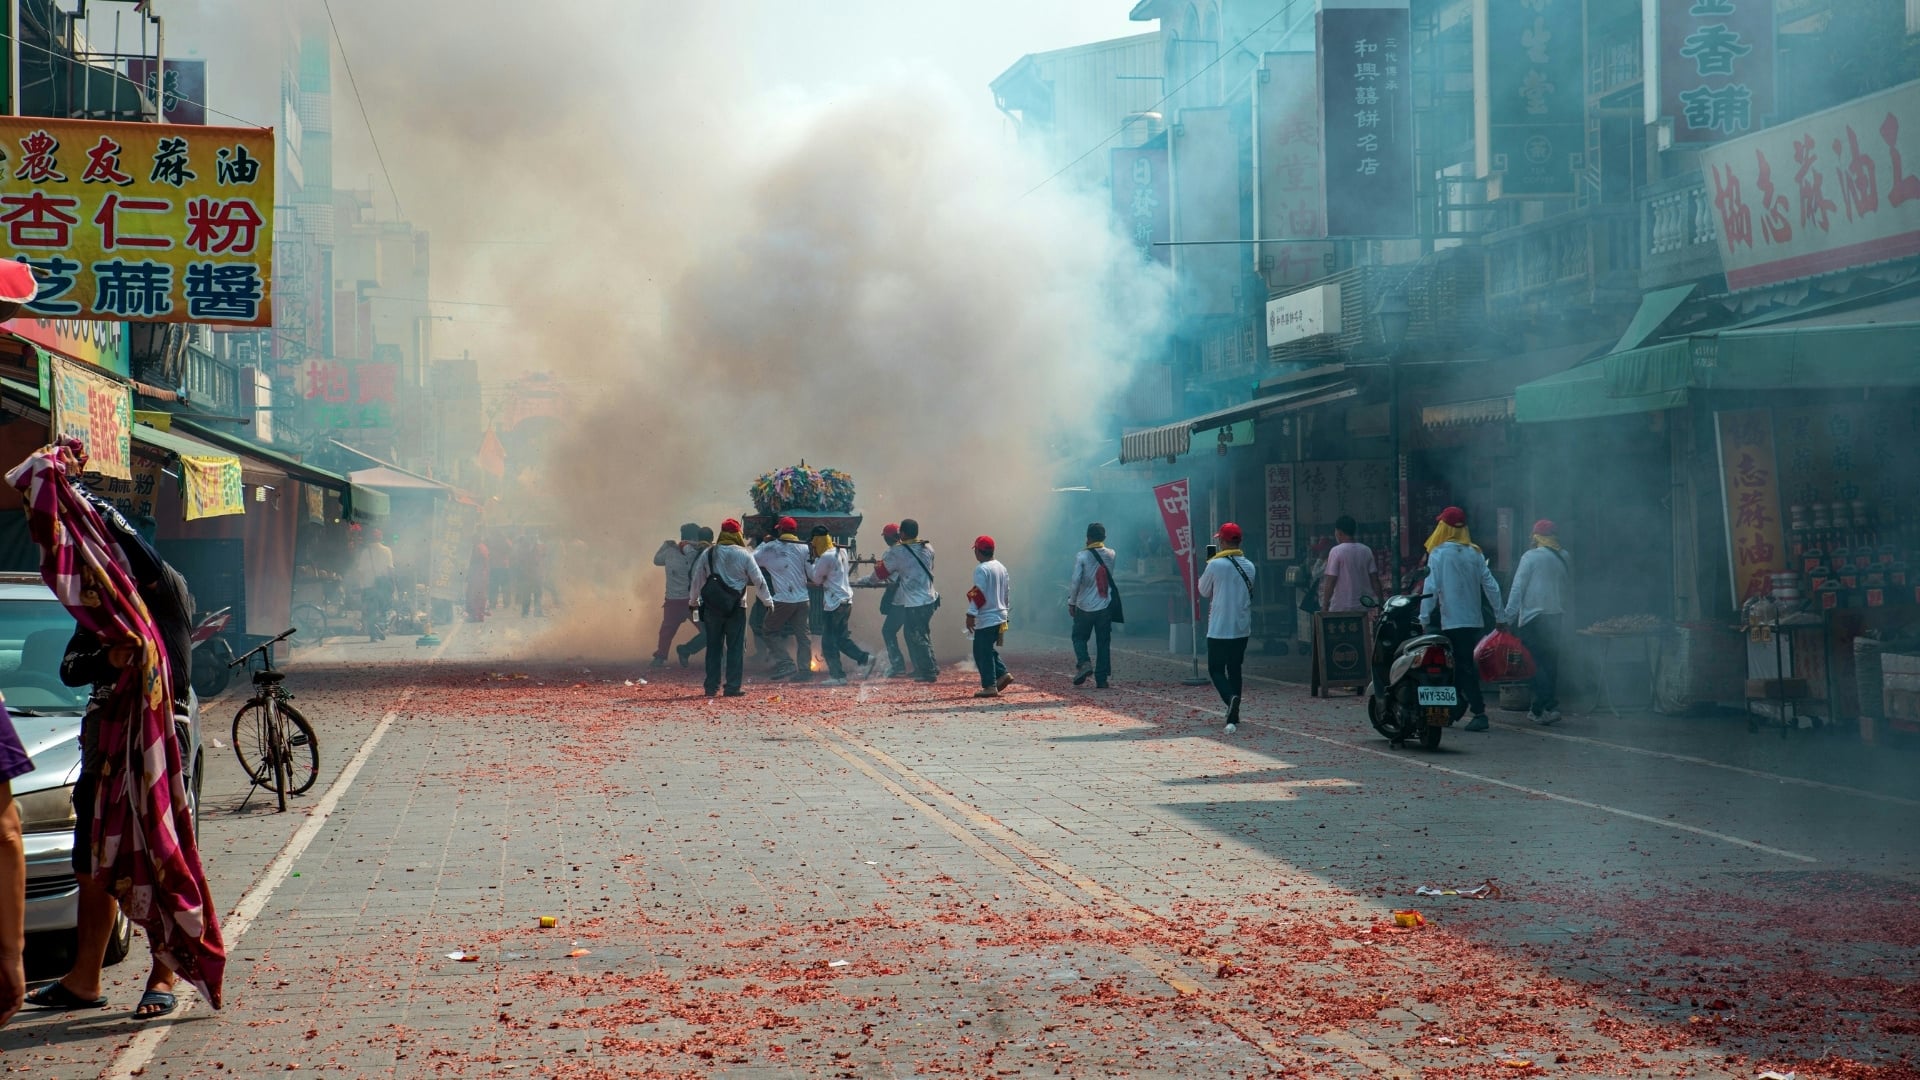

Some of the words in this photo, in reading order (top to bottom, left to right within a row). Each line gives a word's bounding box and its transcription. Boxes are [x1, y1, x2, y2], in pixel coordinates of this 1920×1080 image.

[1519, 0, 1555, 115] 生堂
[0, 191, 263, 254] 杏仁粉
